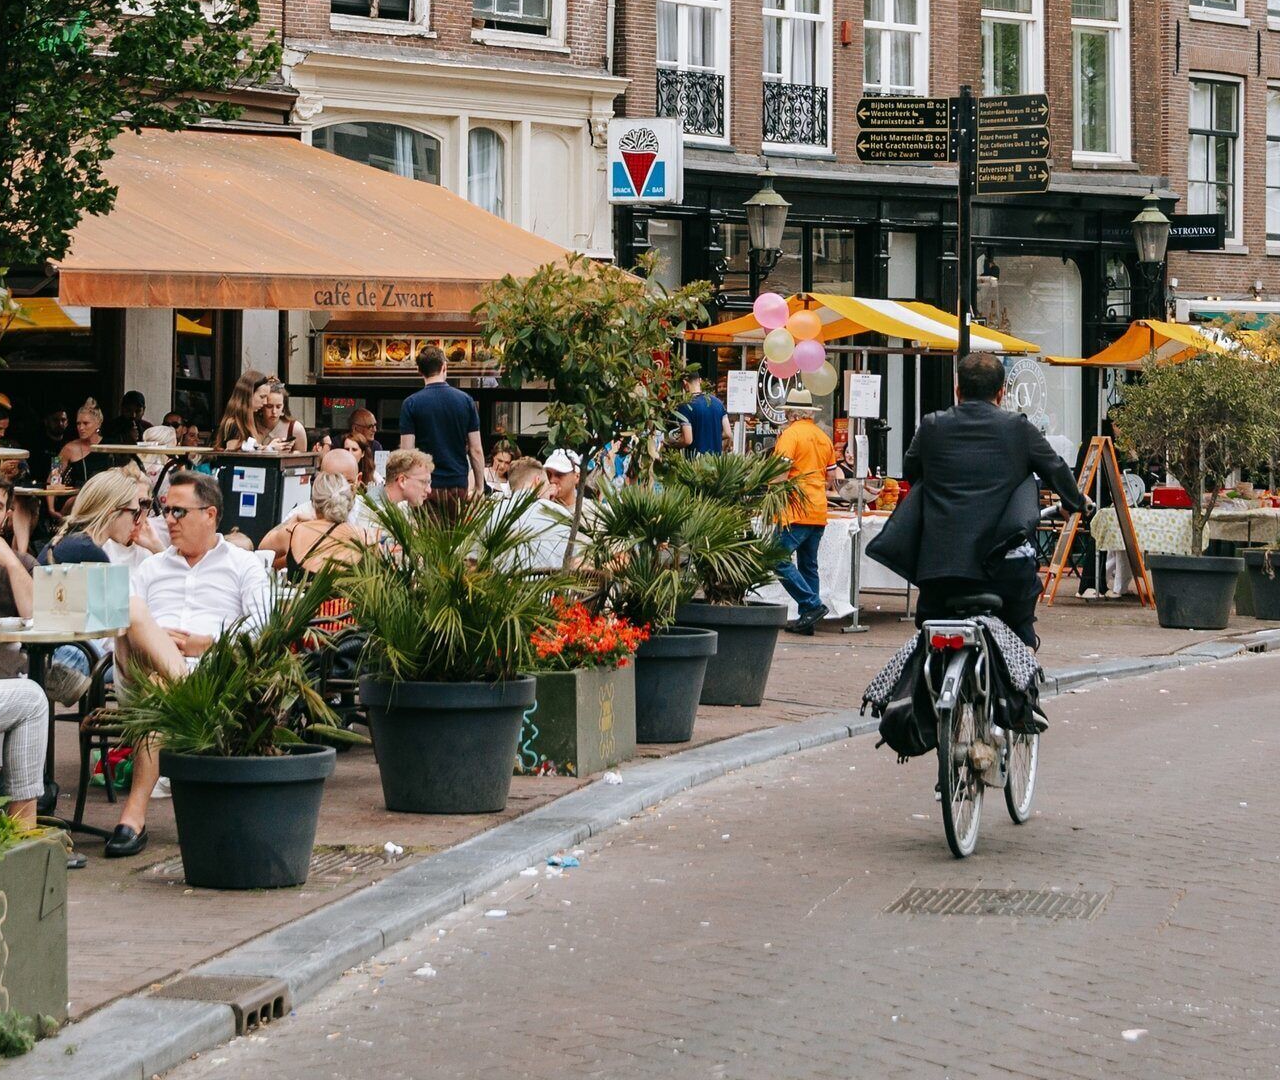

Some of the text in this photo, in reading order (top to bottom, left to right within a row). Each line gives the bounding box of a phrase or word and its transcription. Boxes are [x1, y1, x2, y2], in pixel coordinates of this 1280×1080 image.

[870, 102, 895, 110] Bijbels
[979, 164, 1014, 173] Kalverstraat
[1168, 226, 1216, 235] ASTROVINO
[314, 281, 434, 309] café de Zwart
